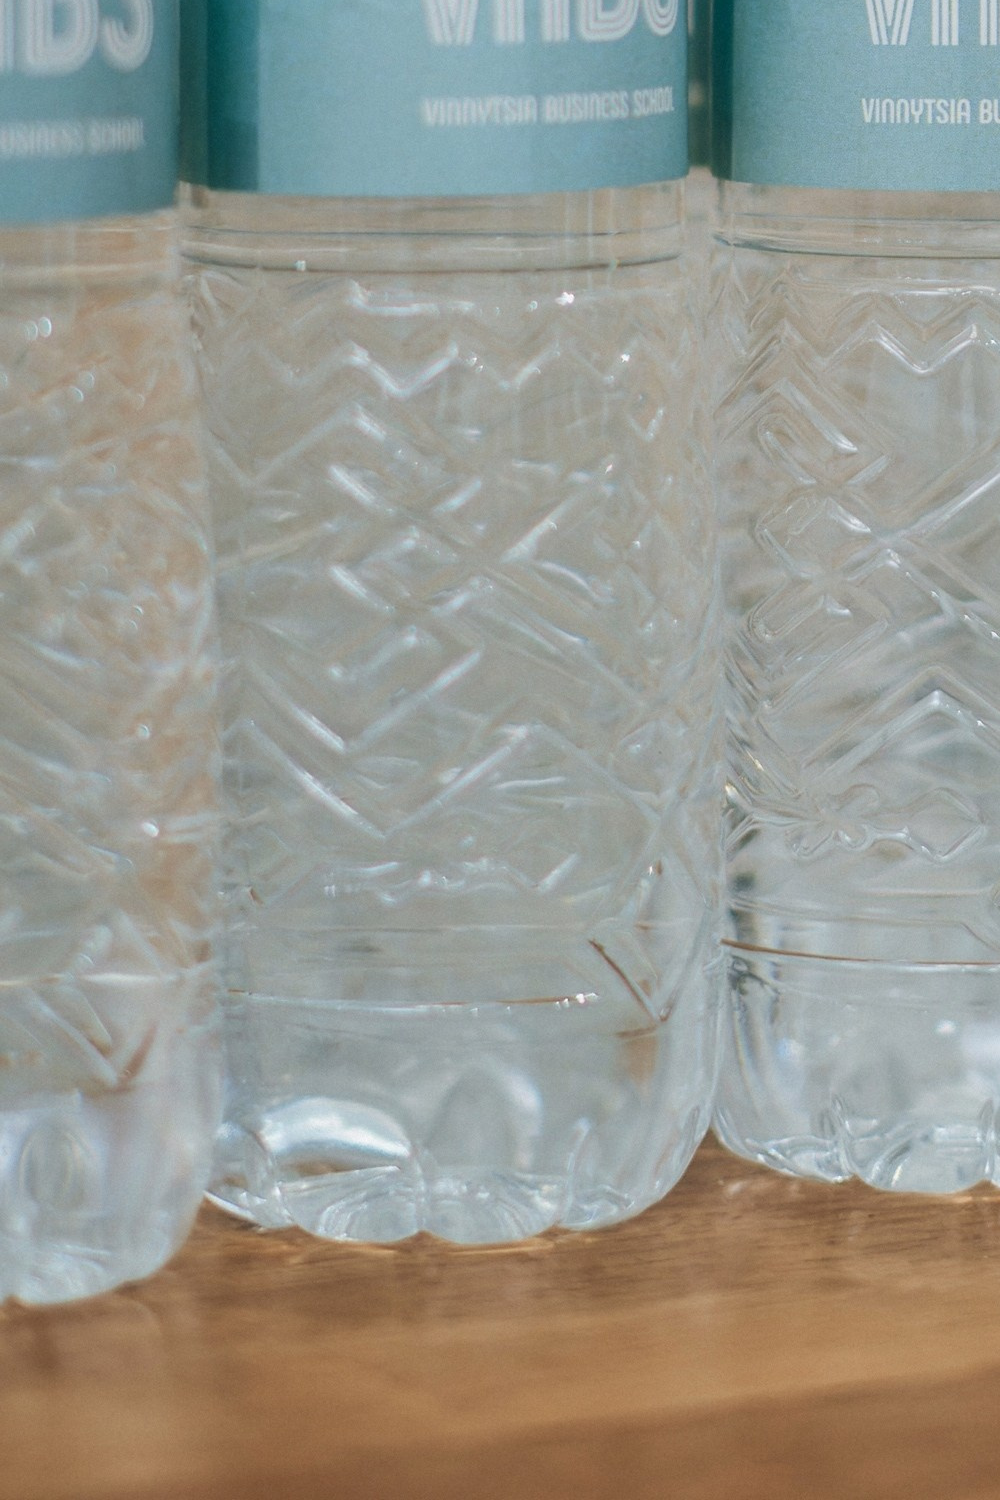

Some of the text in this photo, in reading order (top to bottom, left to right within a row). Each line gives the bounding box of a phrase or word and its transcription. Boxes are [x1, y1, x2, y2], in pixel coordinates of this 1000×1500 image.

[544, 89, 629, 125] BUSINESS
[632, 85, 675, 118] SCHOOL
[861, 97, 971, 125] VINNYTSIA
